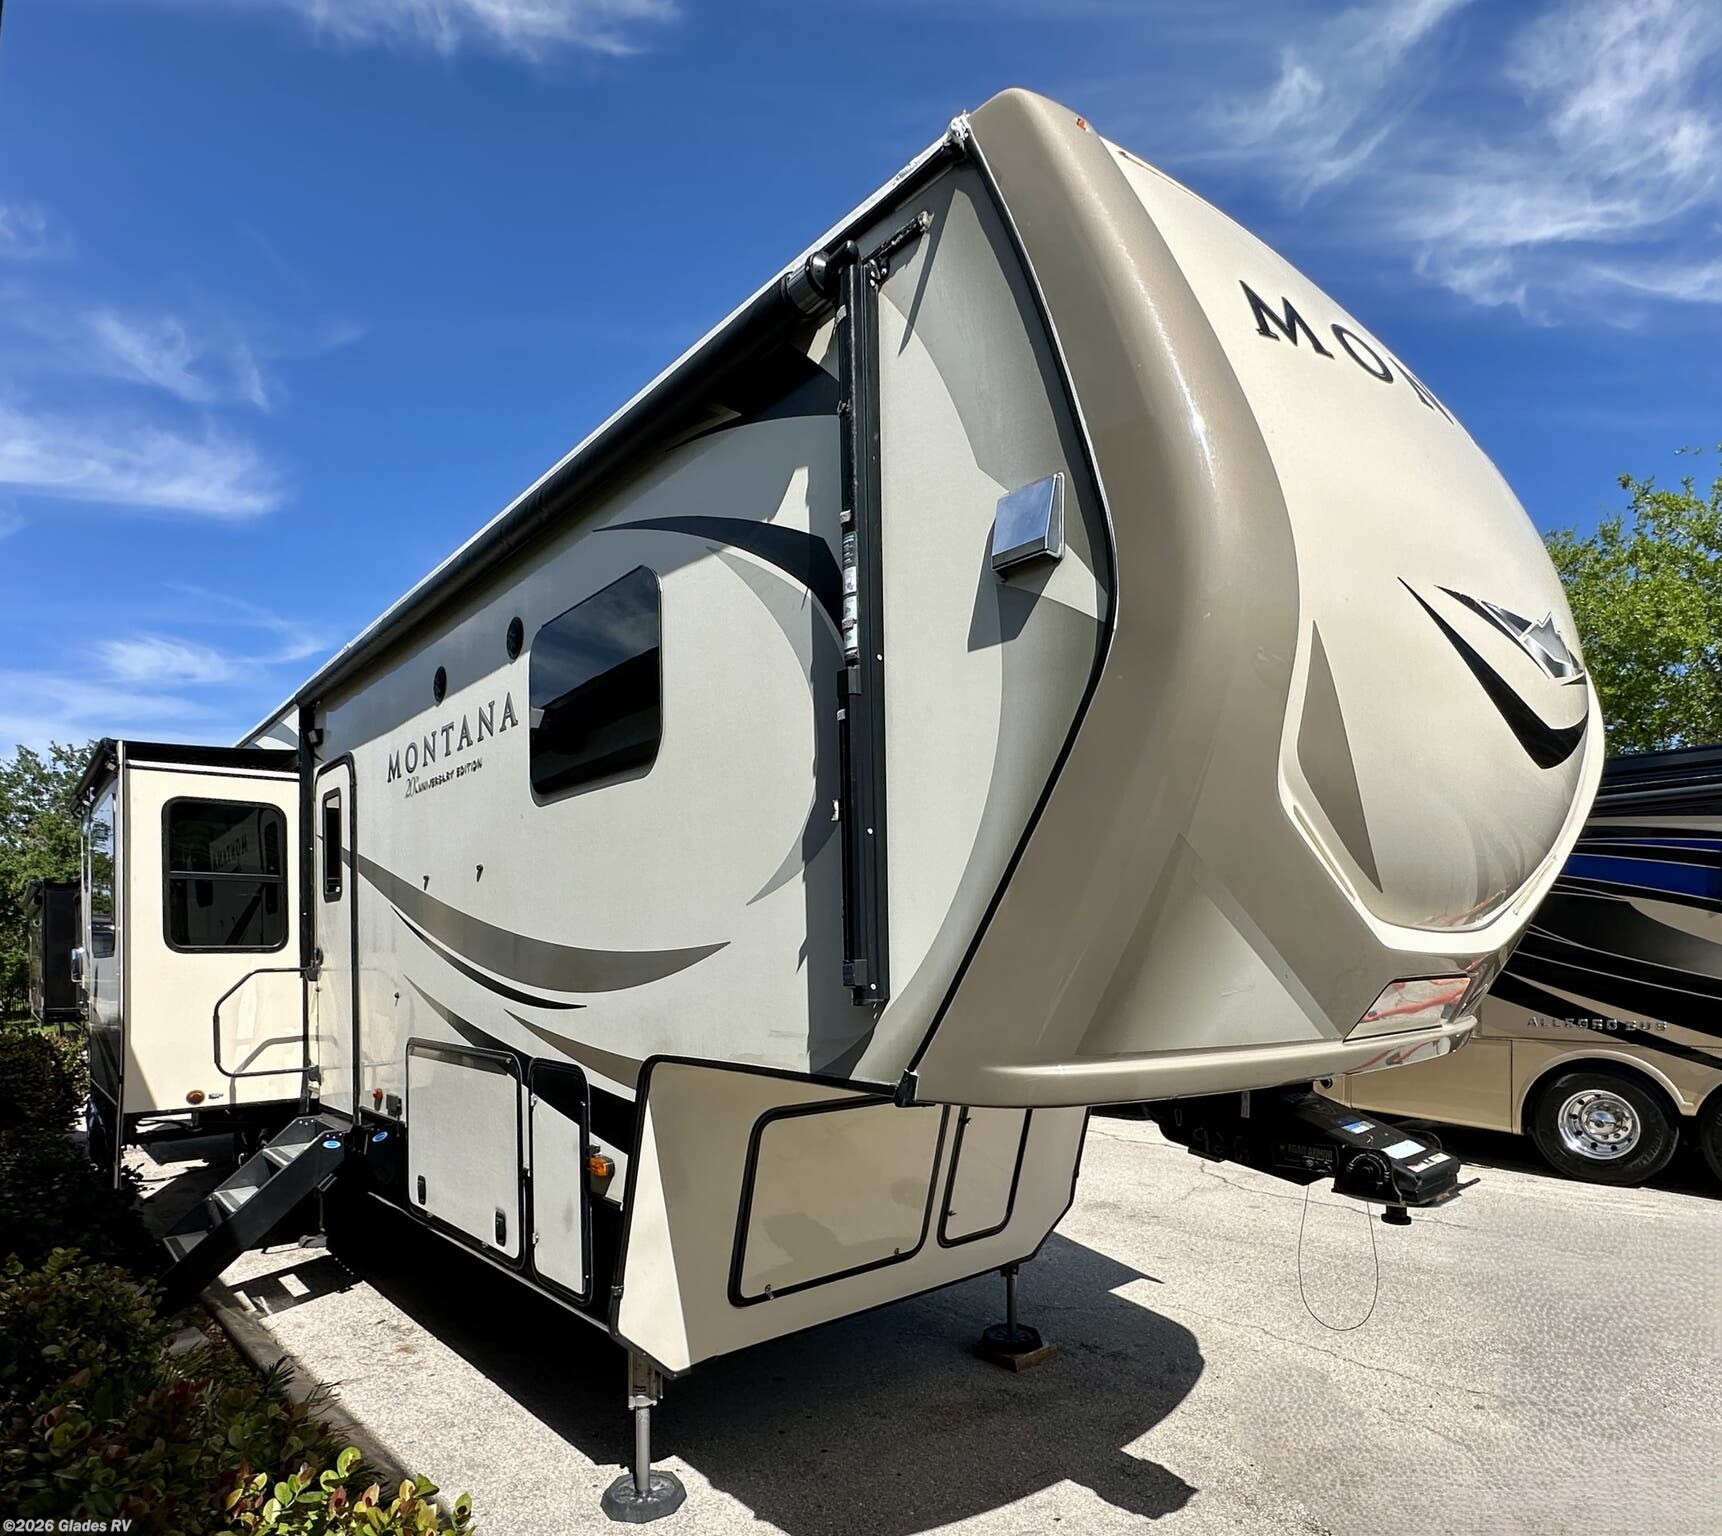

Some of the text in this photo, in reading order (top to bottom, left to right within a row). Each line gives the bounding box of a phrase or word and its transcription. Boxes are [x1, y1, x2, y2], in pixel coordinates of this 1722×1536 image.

[387, 691, 519, 783] MONTANA
[457, 757, 483, 777] EDITION
[1527, 1016, 1668, 1032] ALLEGRO BUS
